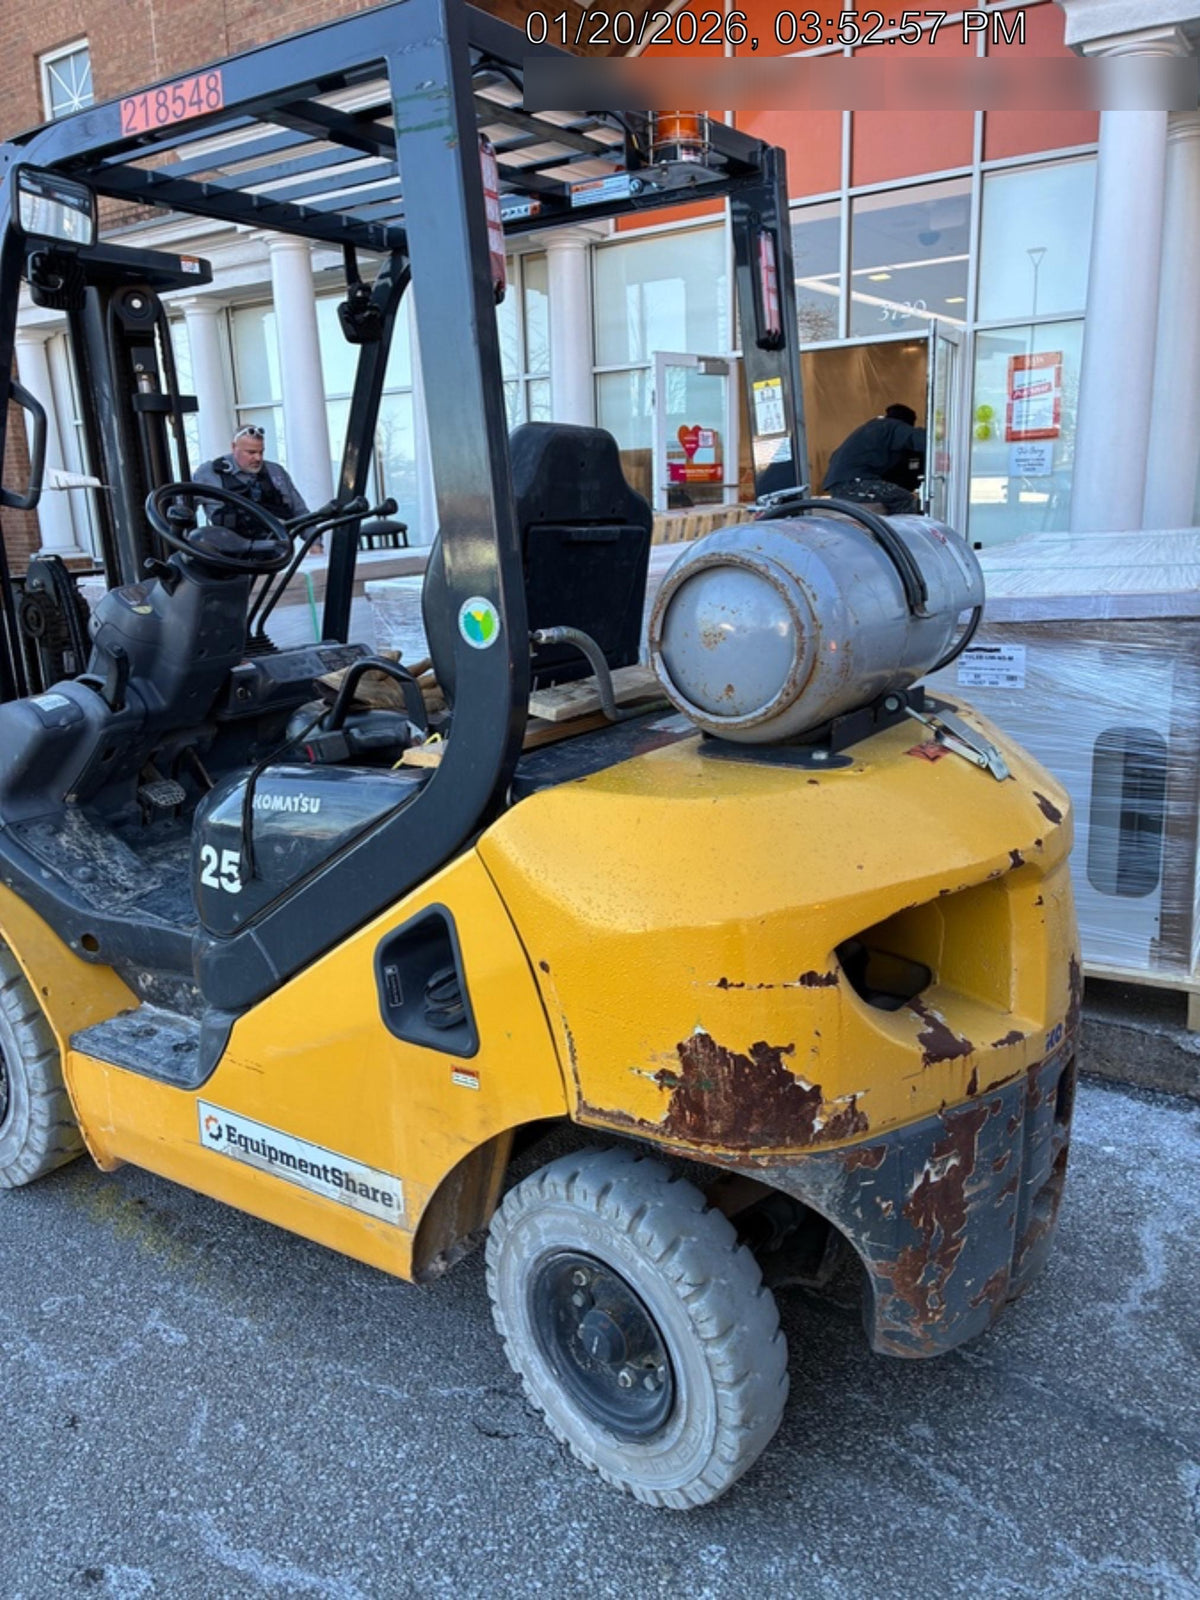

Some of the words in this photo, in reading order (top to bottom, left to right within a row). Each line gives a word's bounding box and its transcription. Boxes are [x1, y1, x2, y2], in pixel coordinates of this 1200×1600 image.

[123, 73, 221, 134] 218548
[252, 793, 321, 814] KOMATSU
[201, 844, 243, 894] 25
[224, 1123, 394, 1208] EquipmentShare
